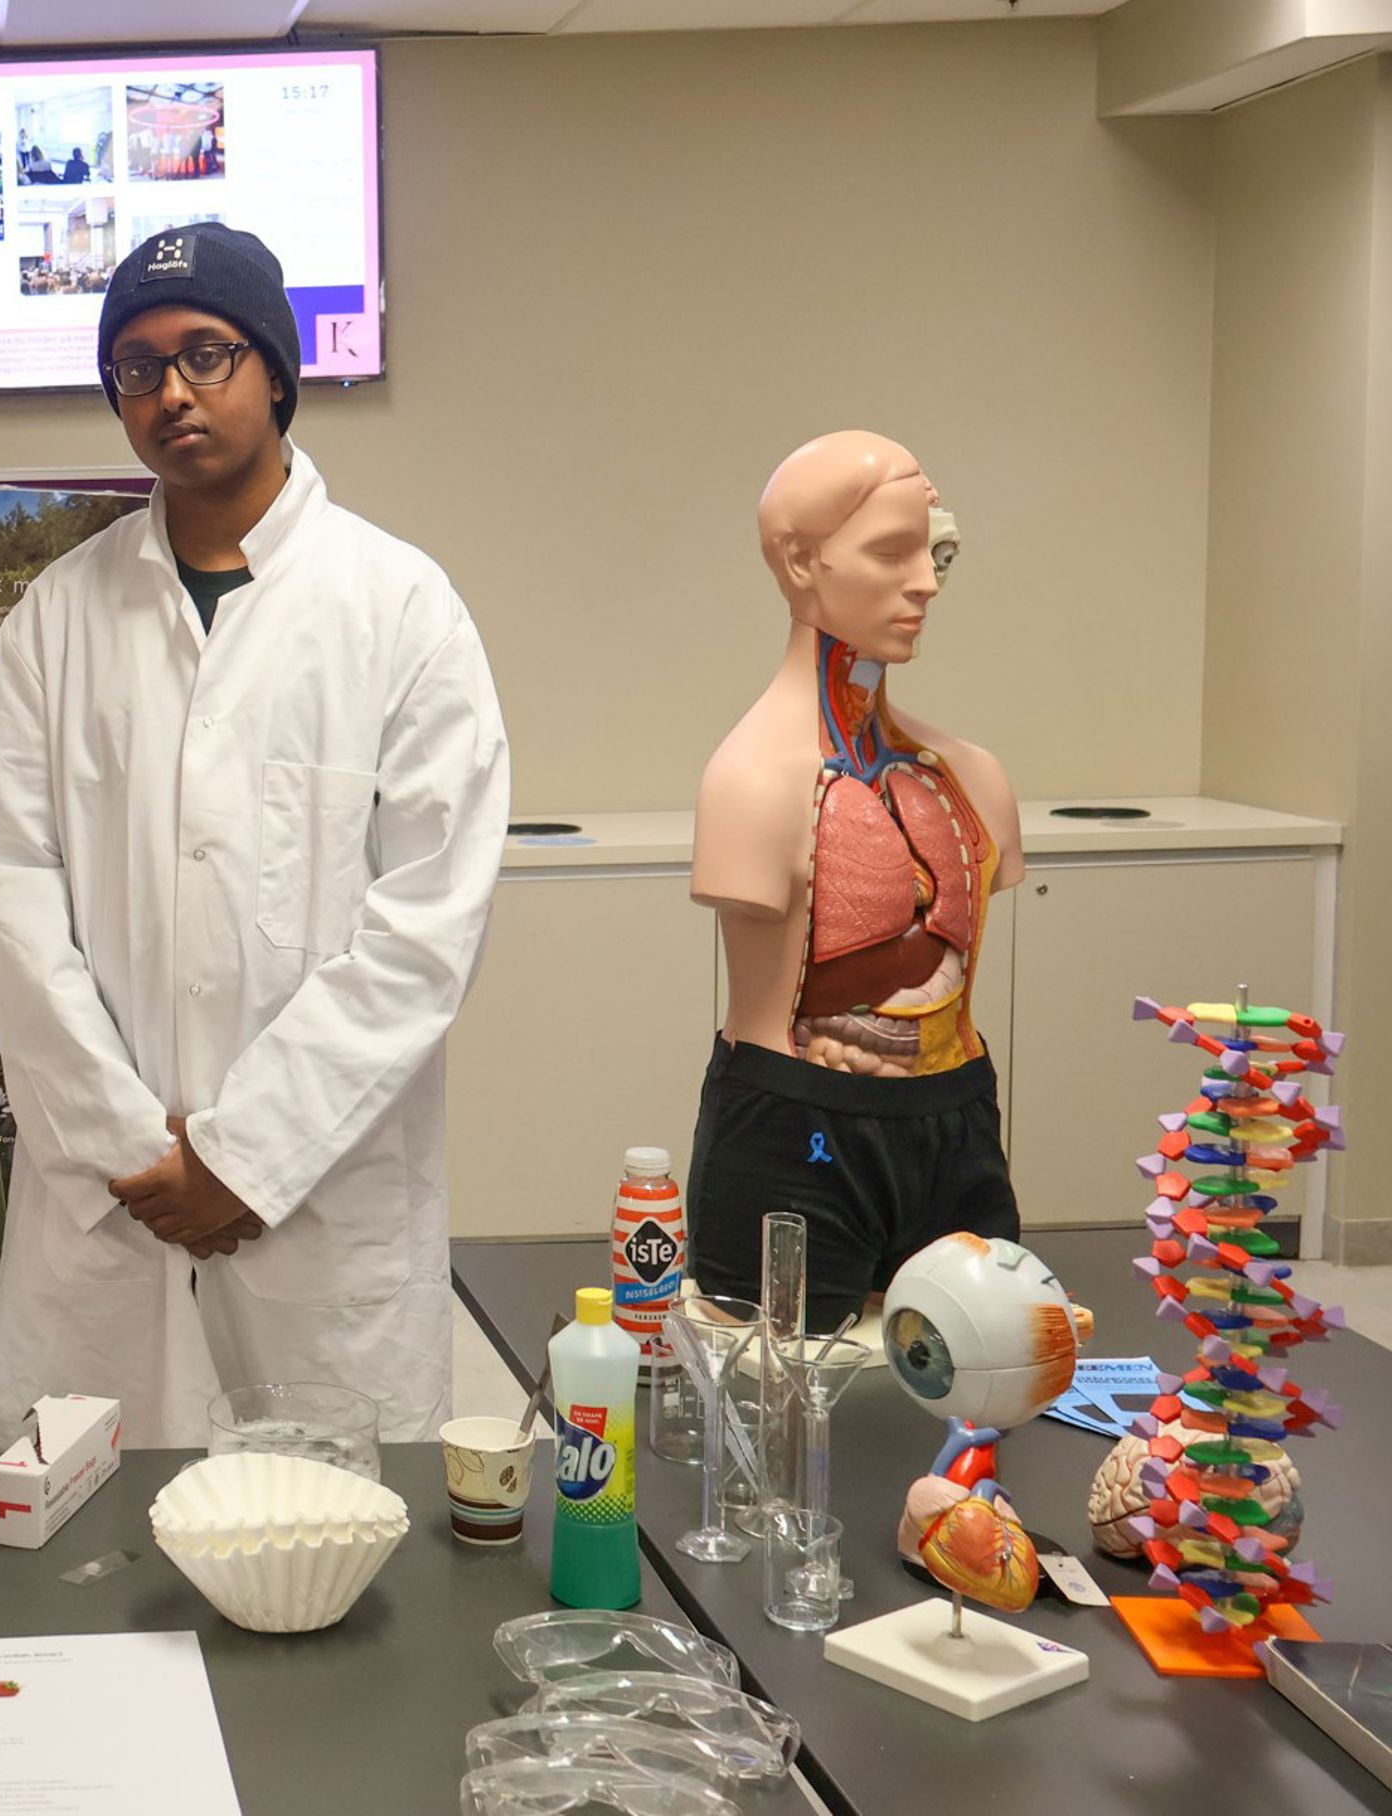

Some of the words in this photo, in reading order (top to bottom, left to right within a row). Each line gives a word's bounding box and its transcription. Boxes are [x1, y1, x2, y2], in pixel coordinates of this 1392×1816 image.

[282, 85, 329, 100] 15:17
[147, 260, 188, 272] Haglöfs
[330, 321, 360, 358] K
